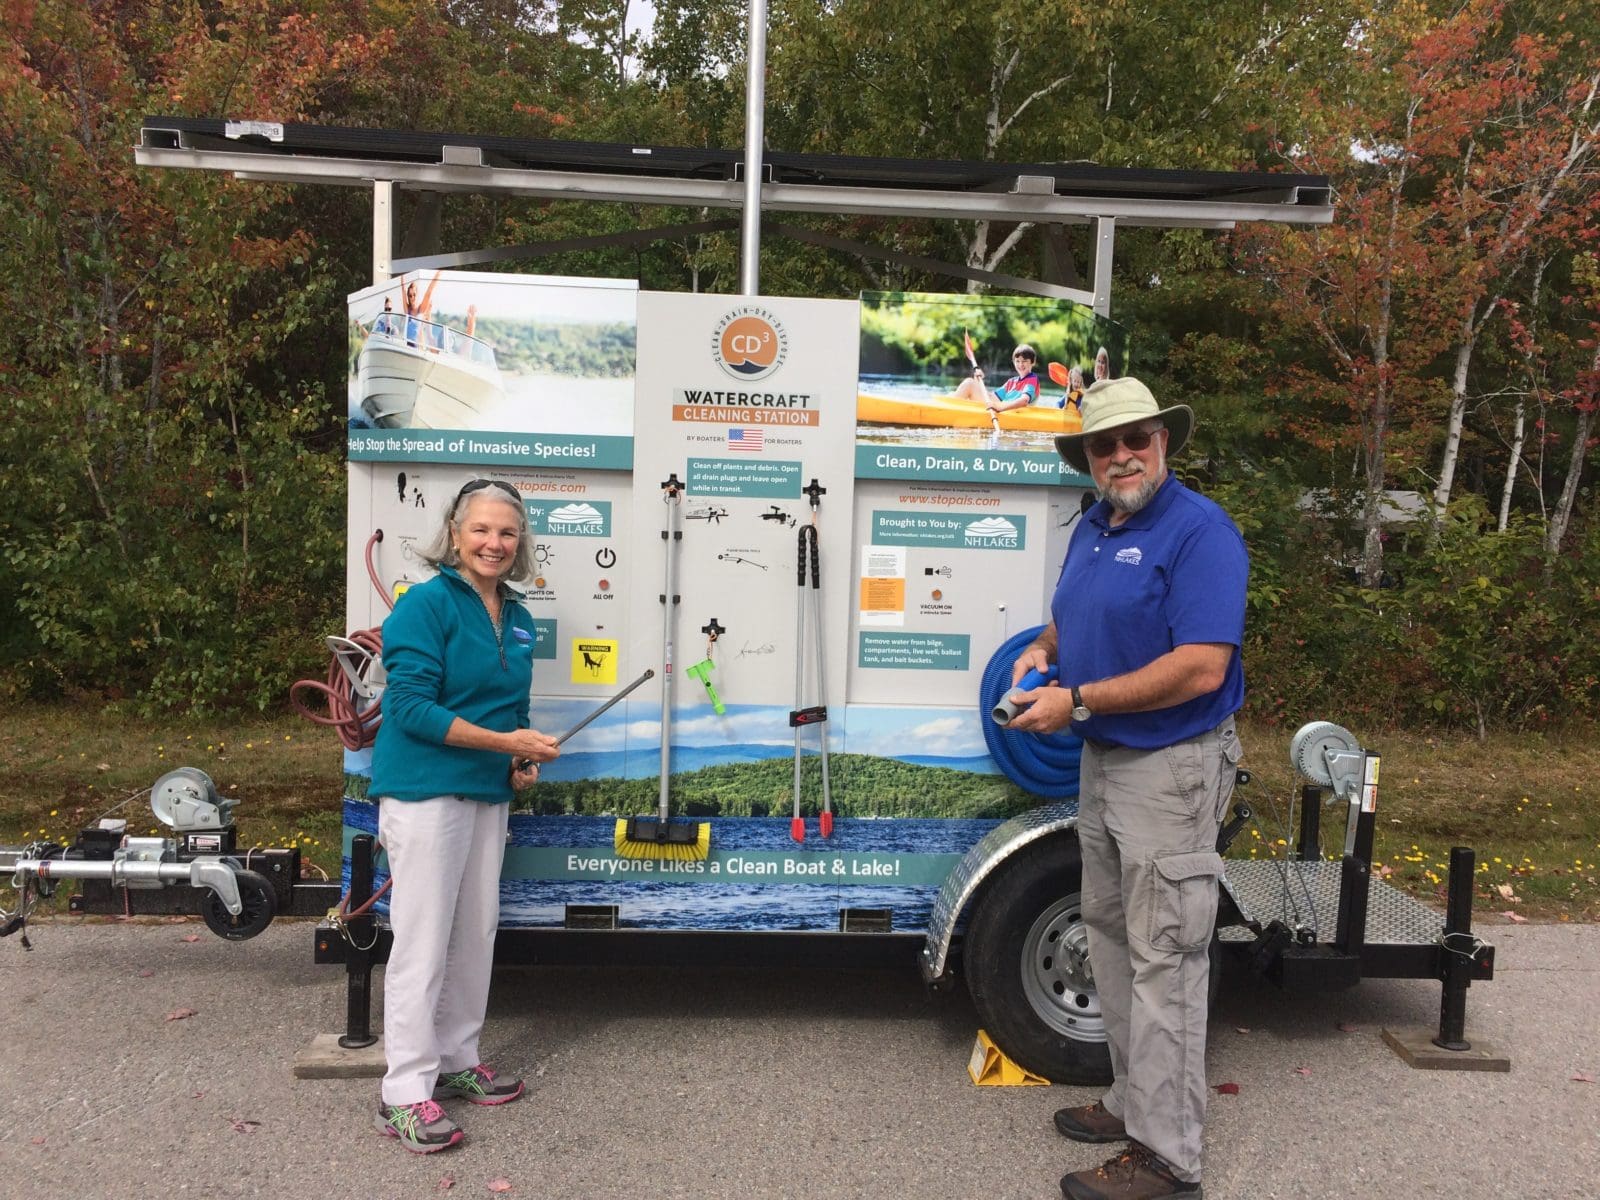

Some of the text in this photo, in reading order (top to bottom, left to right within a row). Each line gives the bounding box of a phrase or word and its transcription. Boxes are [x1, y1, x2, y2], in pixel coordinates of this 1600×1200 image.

[684, 390, 810, 408] WATERCRAFT
[683, 407, 809, 424] CLEANING STATION
[366, 438, 385, 453] Stop
[387, 437, 401, 451] the
[402, 438, 444, 454] Spread
[448, 438, 465, 452] of
[469, 440, 530, 455] Invasive
[534, 442, 596, 459] Species!
[712, 462, 722, 470] off
[723, 463, 743, 472] plants
[757, 464, 780, 472] debris.
[781, 465, 799, 473] Open
[876, 454, 921, 471] Clean,
[925, 456, 969, 473] Drain,
[973, 457, 985, 471] &
[989, 458, 1018, 475] Dry,
[1022, 460, 1055, 474] Your
[720, 474, 738, 483] plugs
[738, 474, 751, 482] and
[752, 475, 769, 483] leave
[770, 476, 788, 484] open
[514, 481, 587, 493] stopais.com
[899, 494, 1000, 508] www.stopais.com
[530, 506, 545, 516] by:
[548, 524, 603, 534] NH LAKES
[879, 517, 962, 530] Brought to You by:
[964, 537, 1017, 548] NH LAKES
[864, 637, 890, 645] Remove
[567, 854, 900, 876] Everyone Likes a Clean Boat & Lake!
